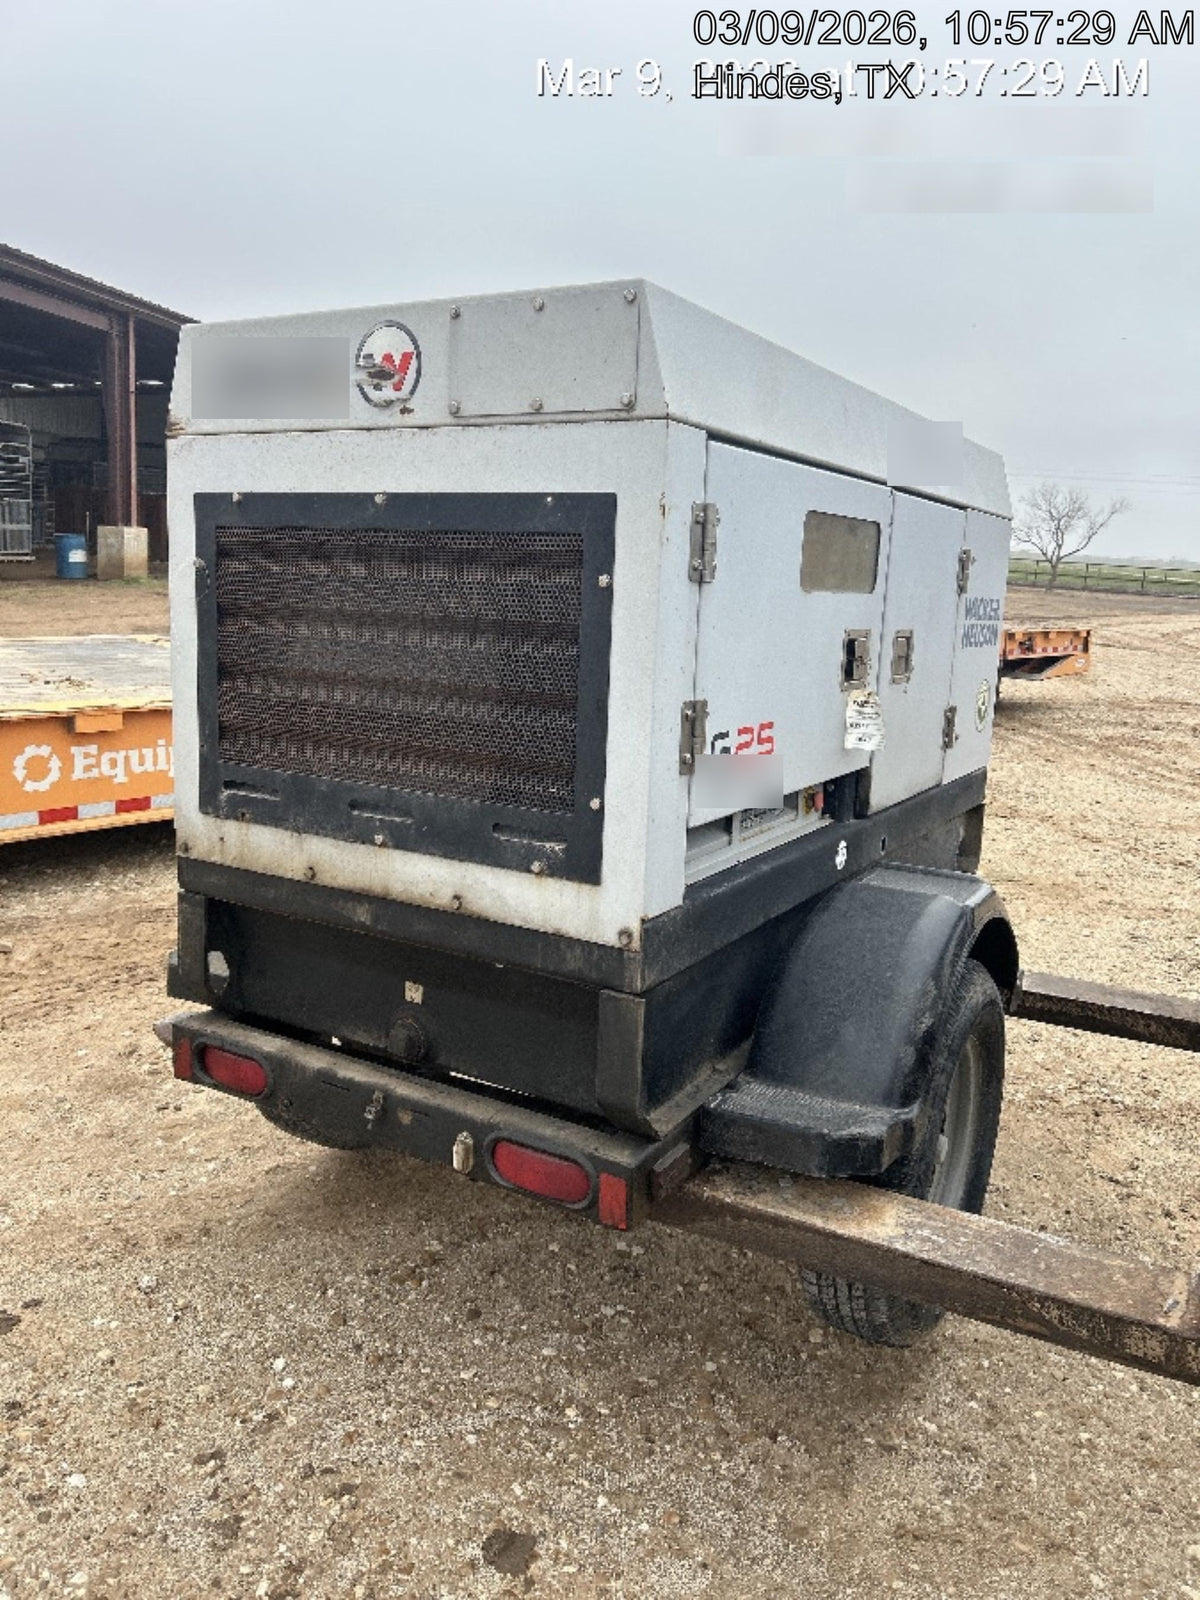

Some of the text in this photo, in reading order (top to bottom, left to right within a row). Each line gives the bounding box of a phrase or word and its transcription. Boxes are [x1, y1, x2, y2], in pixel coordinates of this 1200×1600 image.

[964, 596, 1000, 621] WACKER
[961, 623, 998, 649] NEUSON
[711, 721, 774, 754] G25
[70, 739, 174, 784] Equi
